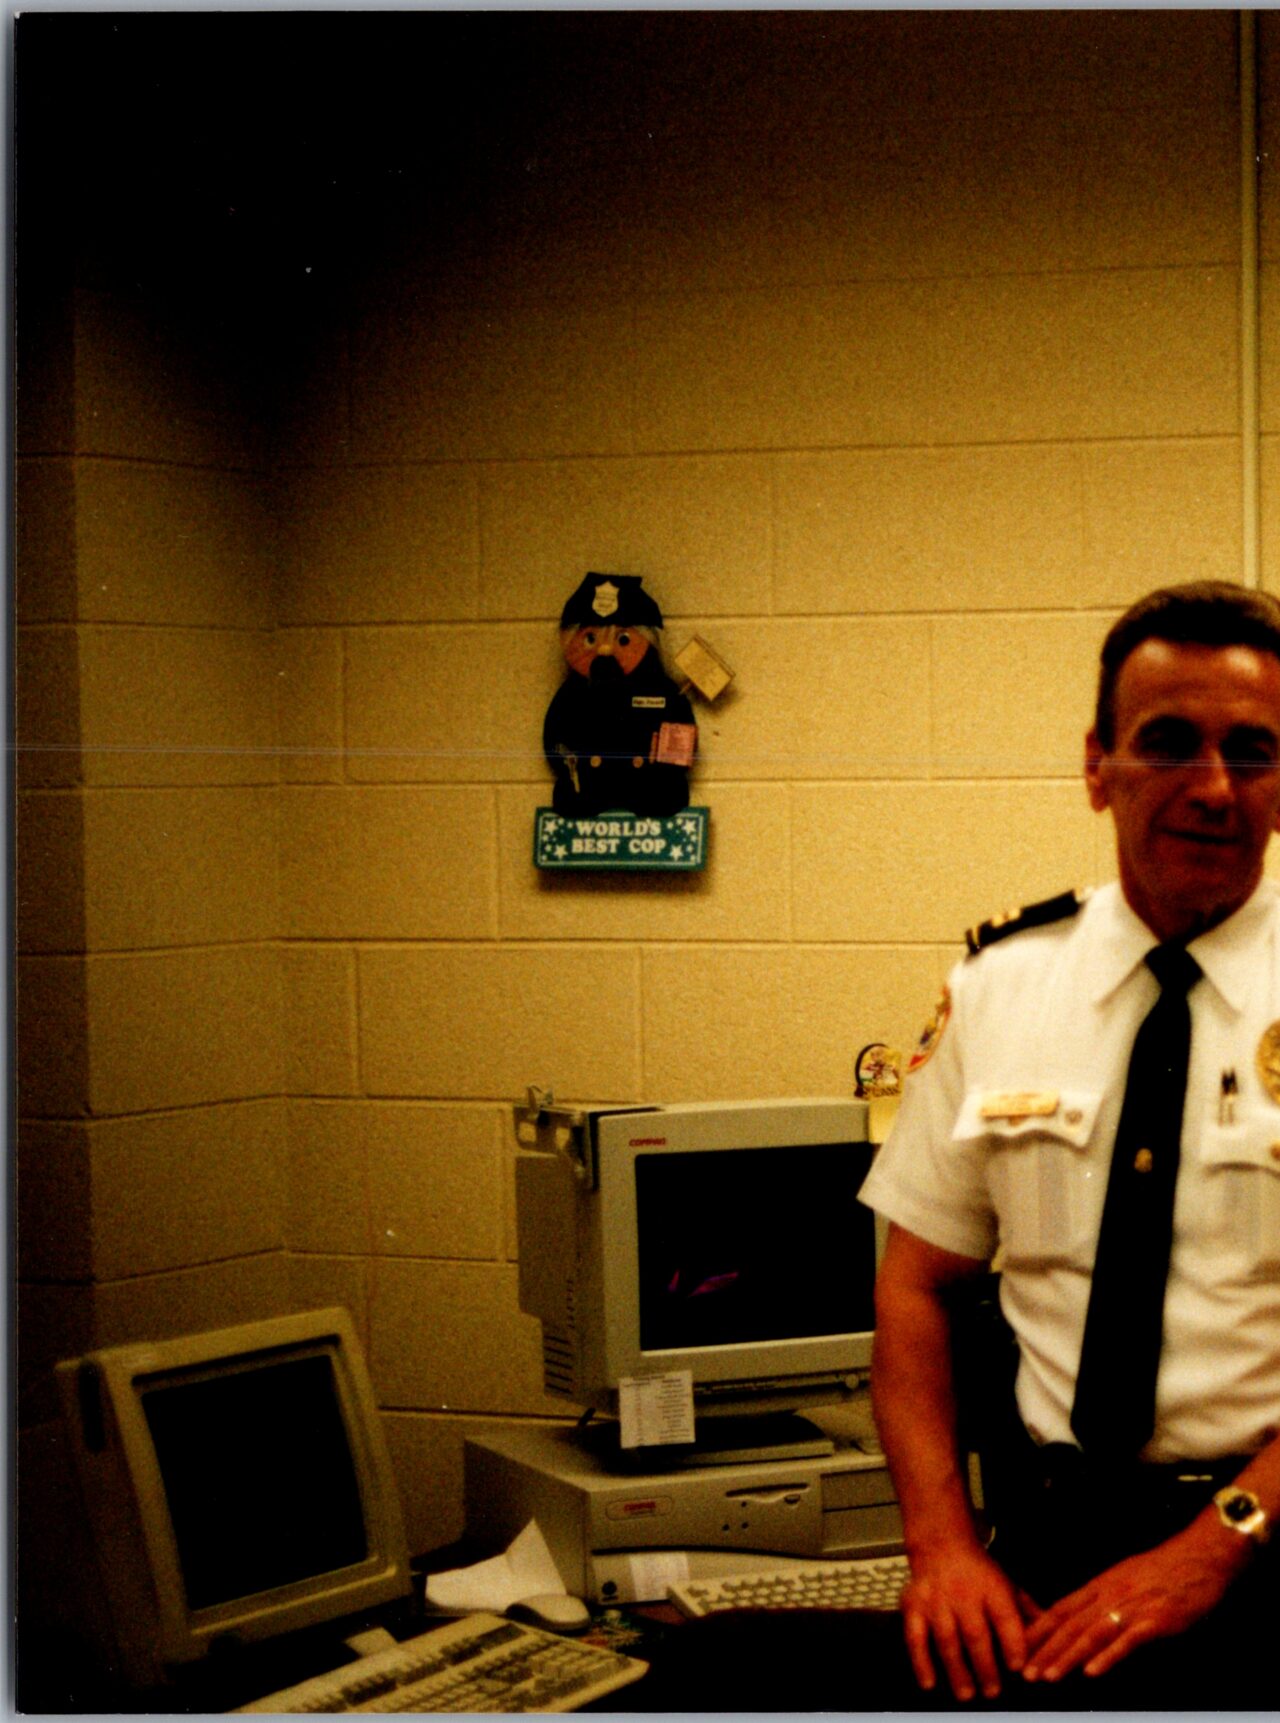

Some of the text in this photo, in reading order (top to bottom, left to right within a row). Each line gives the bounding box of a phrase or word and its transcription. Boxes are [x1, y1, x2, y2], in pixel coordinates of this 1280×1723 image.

[575, 818, 661, 836] WORLD'S
[571, 838, 666, 854] BEST COP
